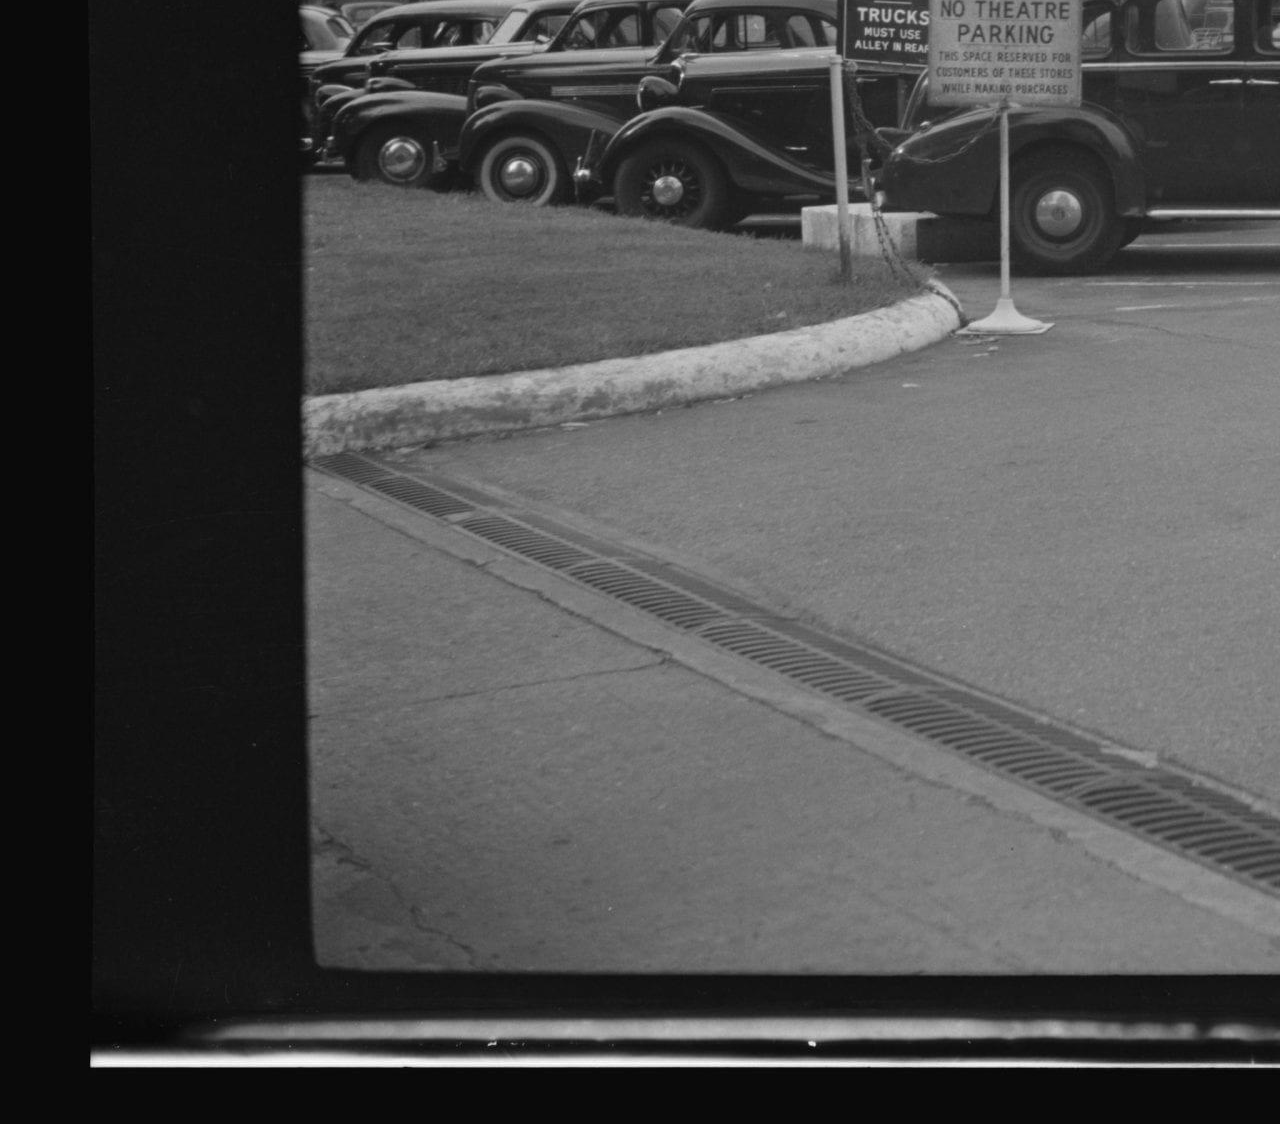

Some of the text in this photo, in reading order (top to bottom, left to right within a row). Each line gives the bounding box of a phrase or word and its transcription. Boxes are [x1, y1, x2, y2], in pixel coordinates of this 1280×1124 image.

[857, 7, 930, 26] TRUCKS
[940, 0, 1070, 20] NO THEATRE
[864, 26, 921, 40] MUST USE
[957, 24, 1055, 44] PARKING
[855, 40, 889, 50] ALLEY
[893, 42, 902, 51] IN
[939, 51, 1072, 63] THIS SPACE RESERVED FOR
[935, 66, 1073, 79] CUSTOMERS OF THESE STORES
[941, 83, 1069, 95] WHILE MAKING PURCHASES
